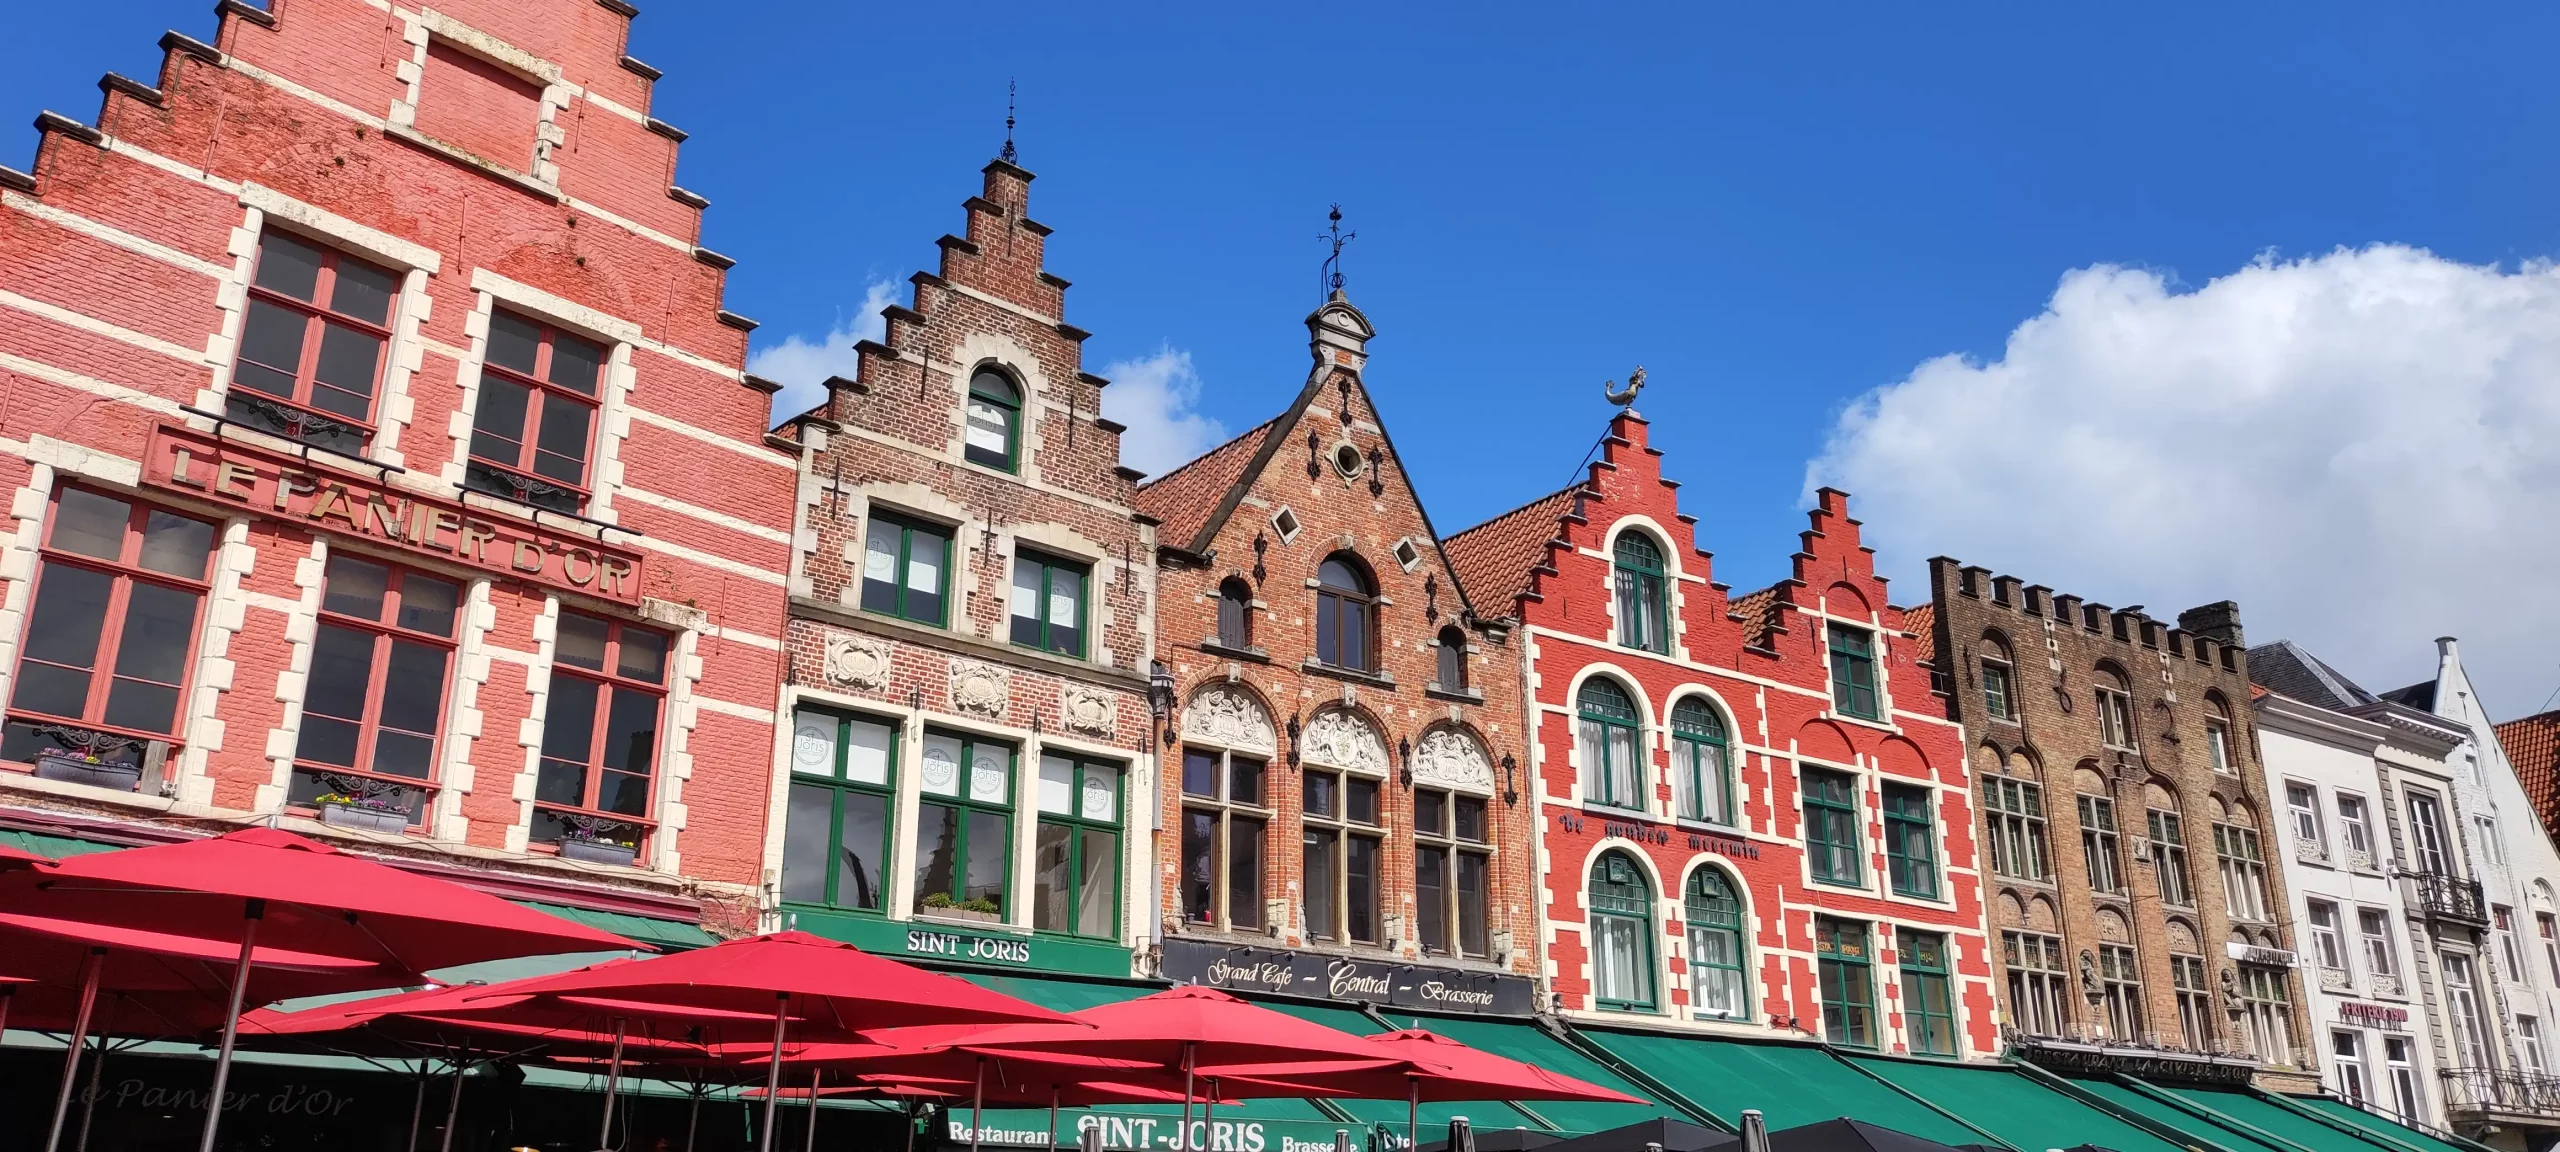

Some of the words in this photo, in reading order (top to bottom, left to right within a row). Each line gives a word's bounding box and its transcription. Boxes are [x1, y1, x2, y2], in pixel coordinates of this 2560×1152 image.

[171, 447, 257, 502] LE
[274, 466, 496, 562] PANIER
[513, 538, 632, 595] D'OR
[907, 930, 960, 956] SINT
[968, 937, 1030, 963] JORIS
[1207, 959, 1258, 985] Grand
[1328, 961, 1392, 998] Central
[1420, 980, 1494, 1006] Brasserie
[268, 1084, 355, 1117] d'Or
[1281, 1135, 1358, 1152] Brassee
